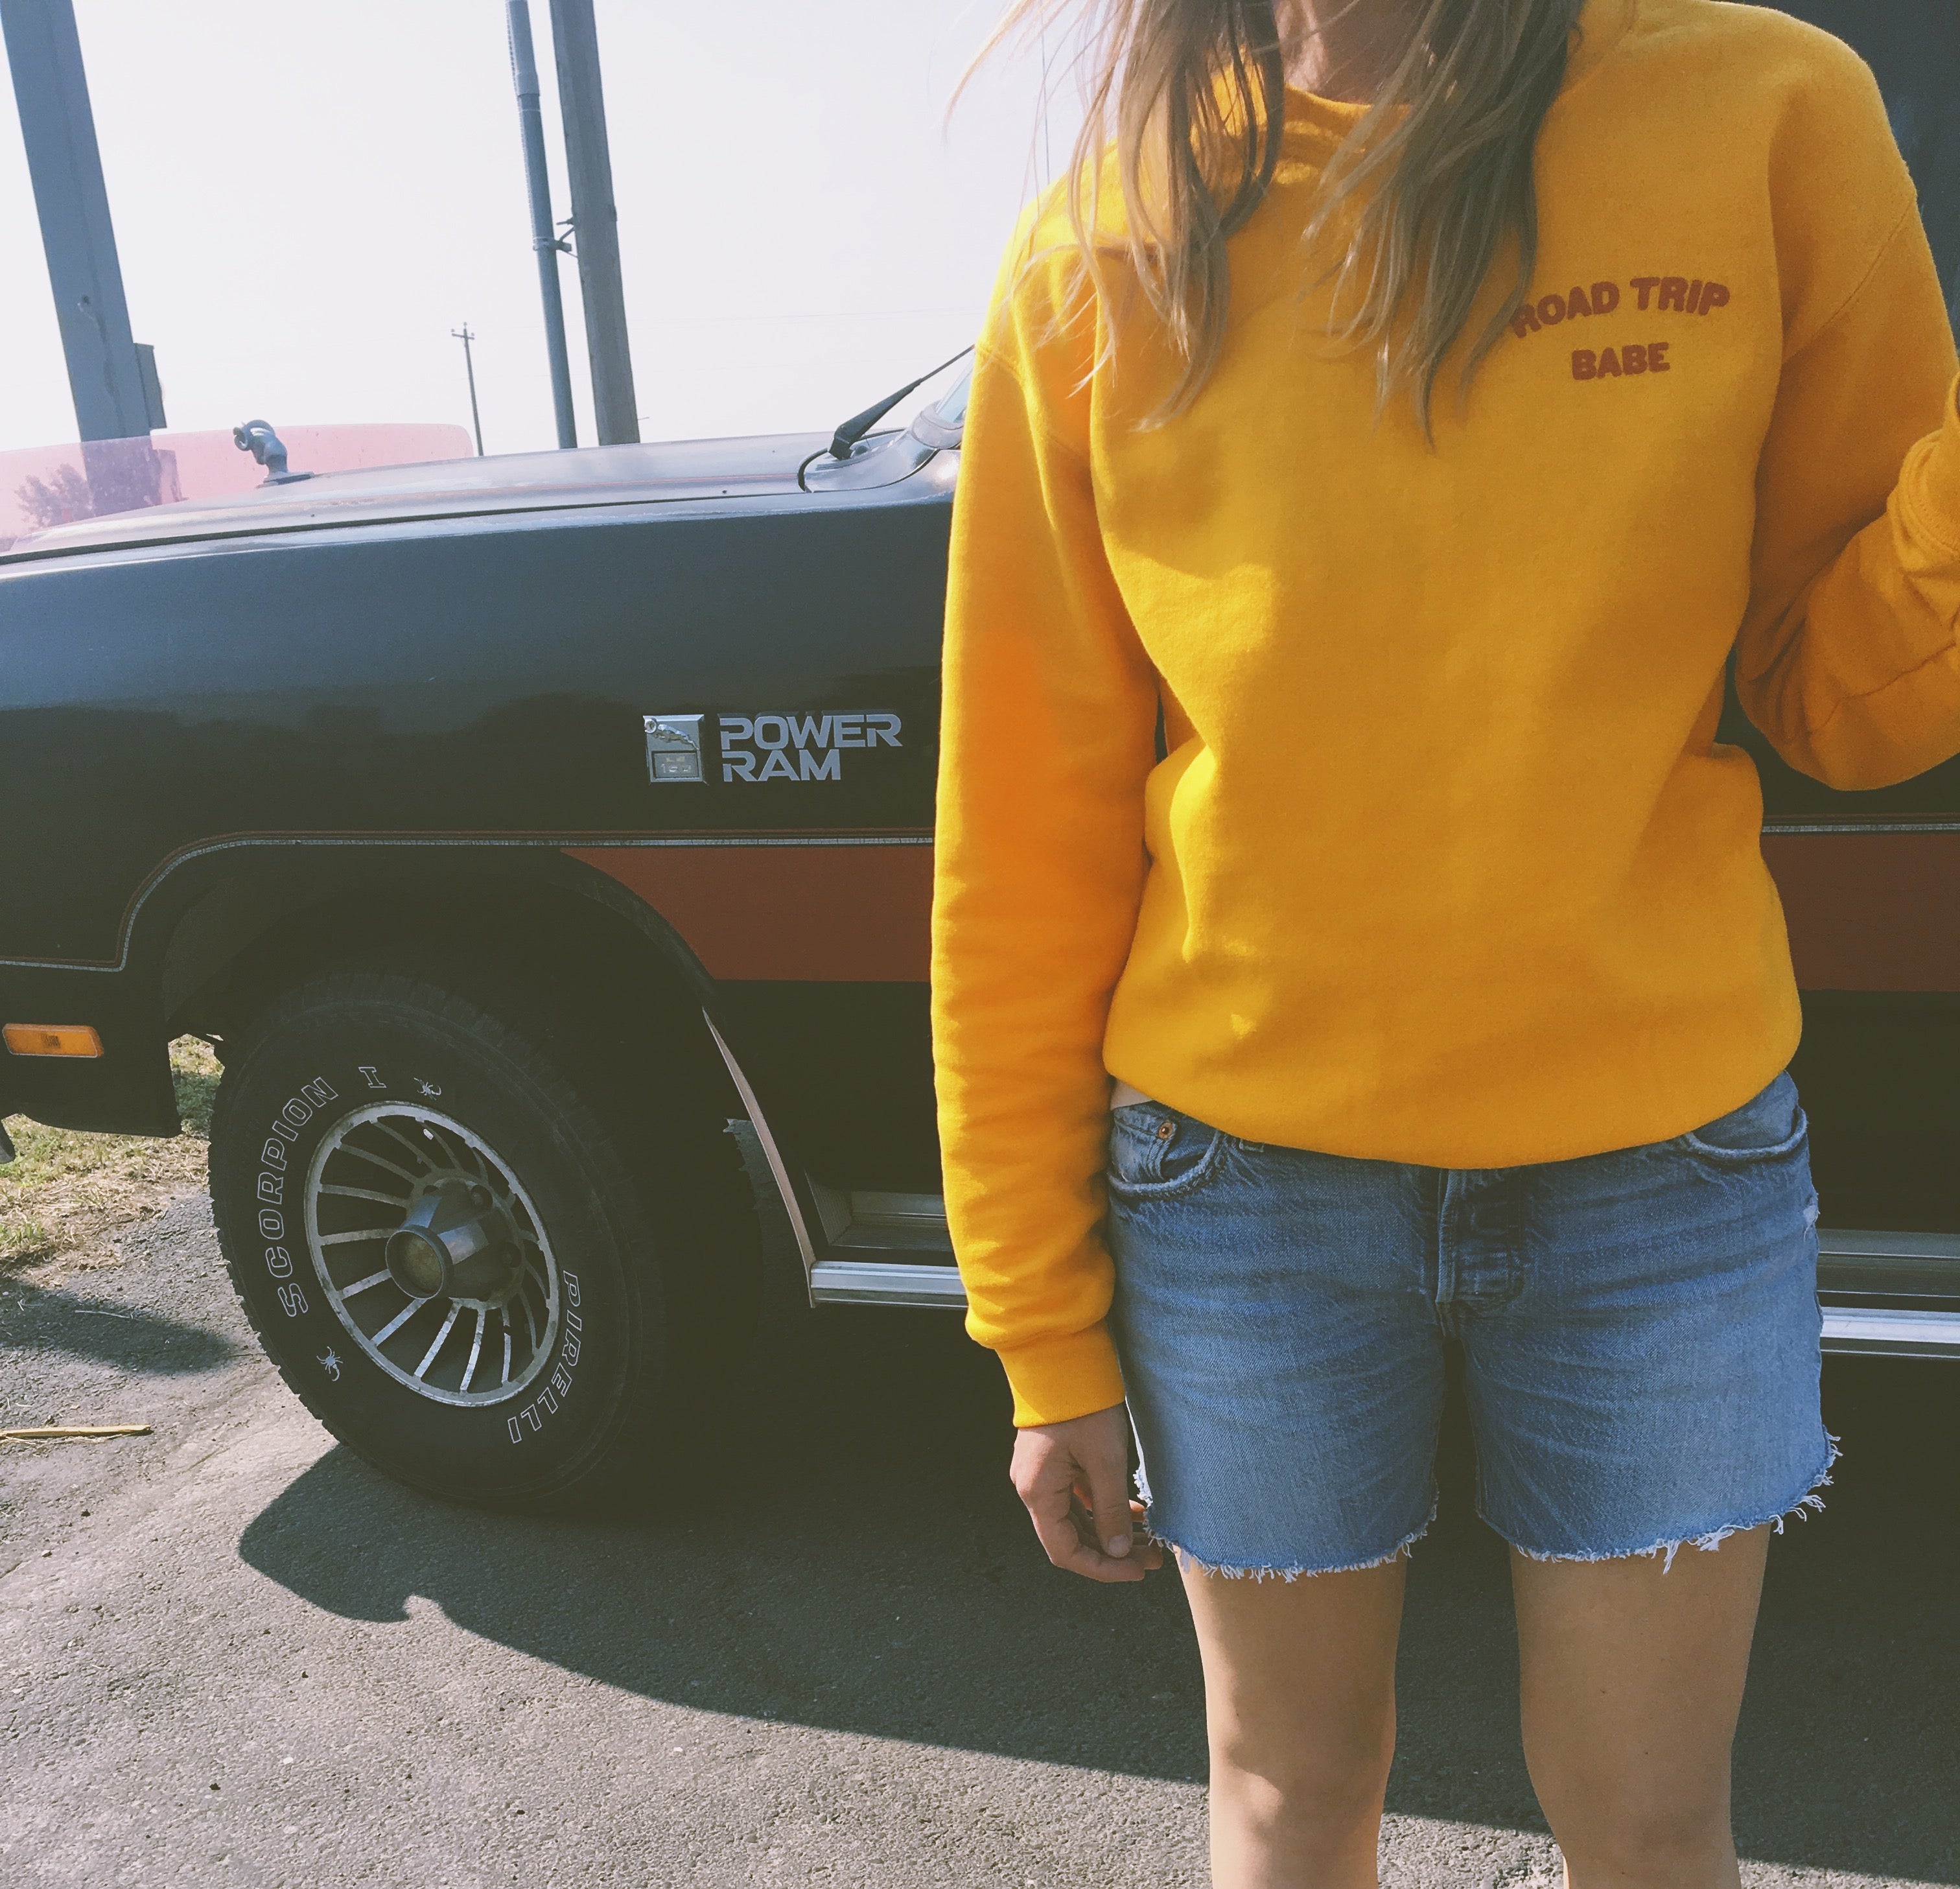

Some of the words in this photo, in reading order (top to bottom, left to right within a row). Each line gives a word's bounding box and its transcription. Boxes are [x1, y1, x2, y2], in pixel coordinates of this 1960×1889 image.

[1509, 281, 1620, 338] ROAD
[1629, 277, 1731, 316] TRIP
[1571, 342, 1670, 381] BABE
[719, 714, 903, 750] POWER
[721, 749, 841, 782] RAM
[257, 1077, 339, 1317] SCORPION
[507, 1270, 582, 1444] PIRELLI
